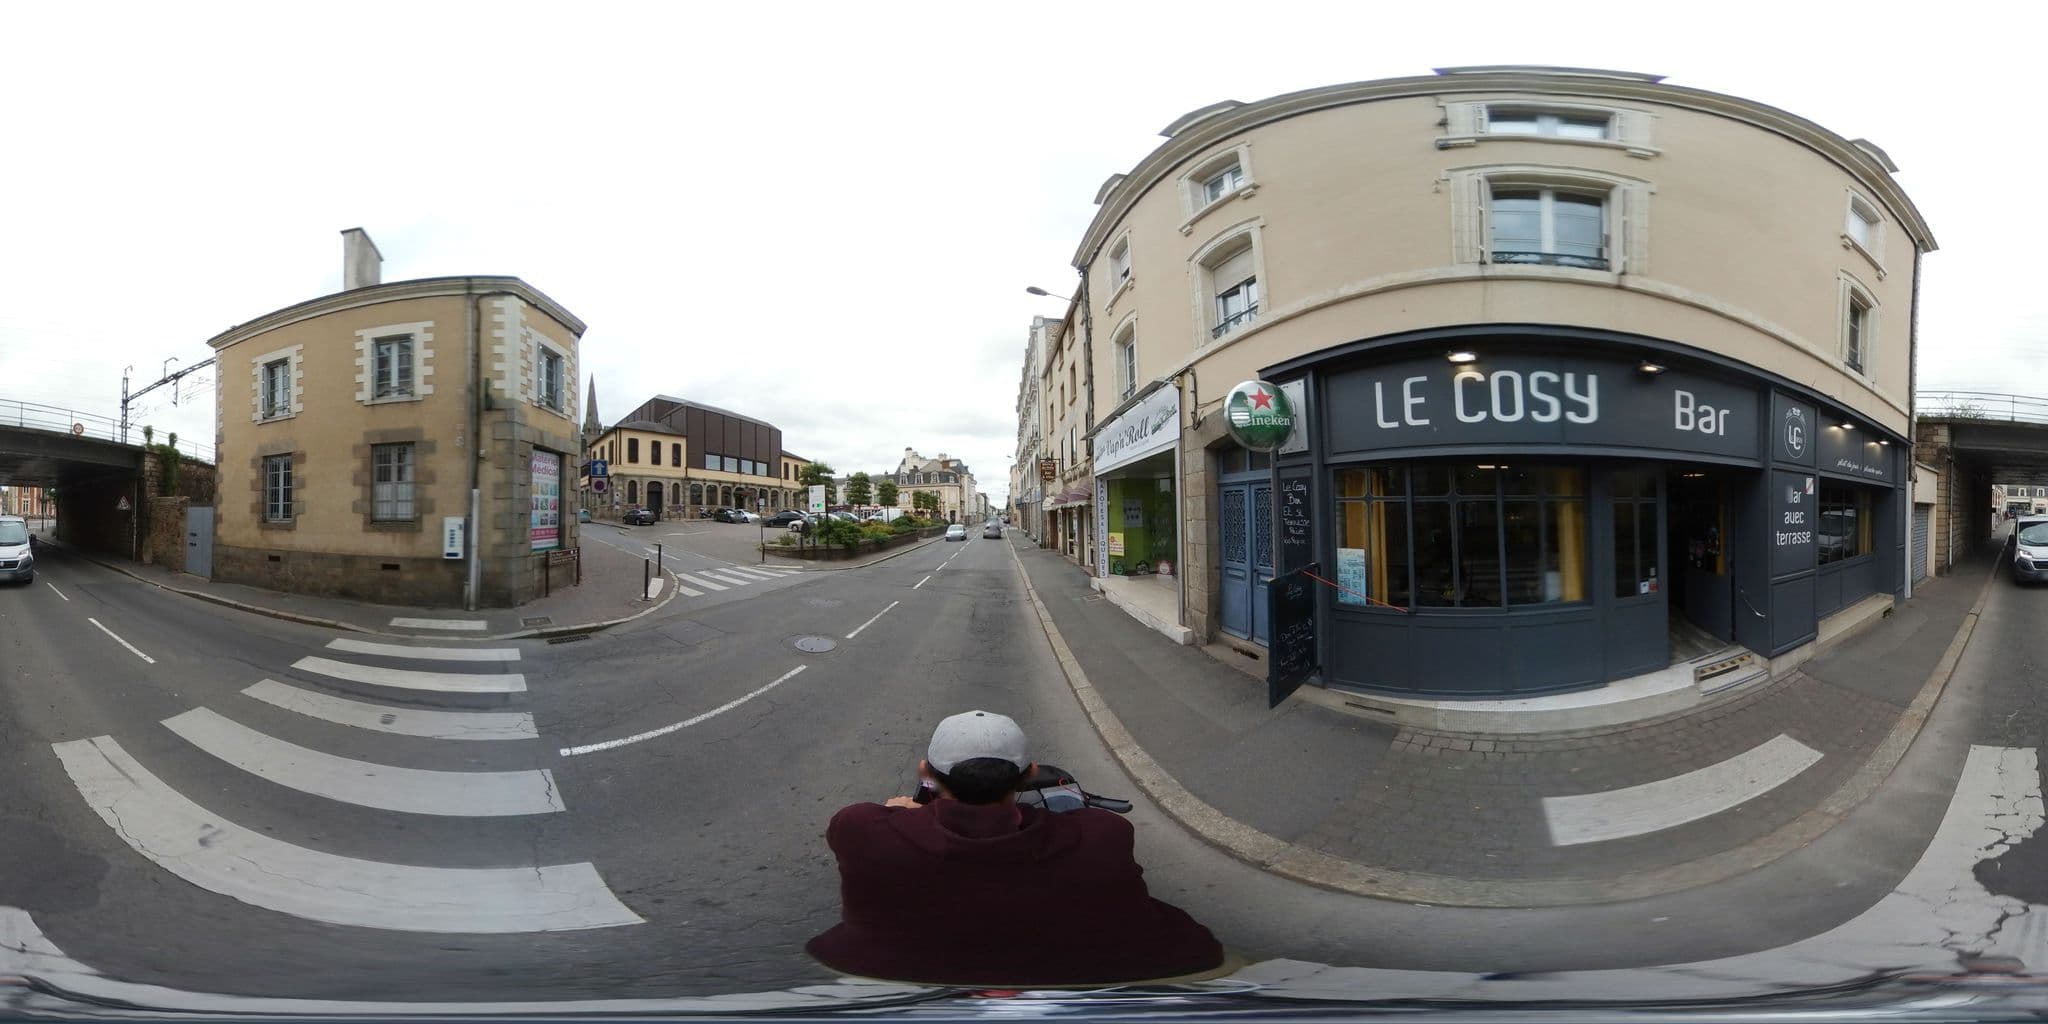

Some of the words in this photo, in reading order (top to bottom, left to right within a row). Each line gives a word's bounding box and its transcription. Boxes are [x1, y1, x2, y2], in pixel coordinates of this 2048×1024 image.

[1375, 376, 1430, 429] LE
[1453, 370, 1598, 424] COSY
[1236, 413, 1291, 428] eineken
[1675, 390, 1730, 436] Bar
[1784, 511, 1805, 524] avec
[1776, 530, 1811, 546] terrasse
